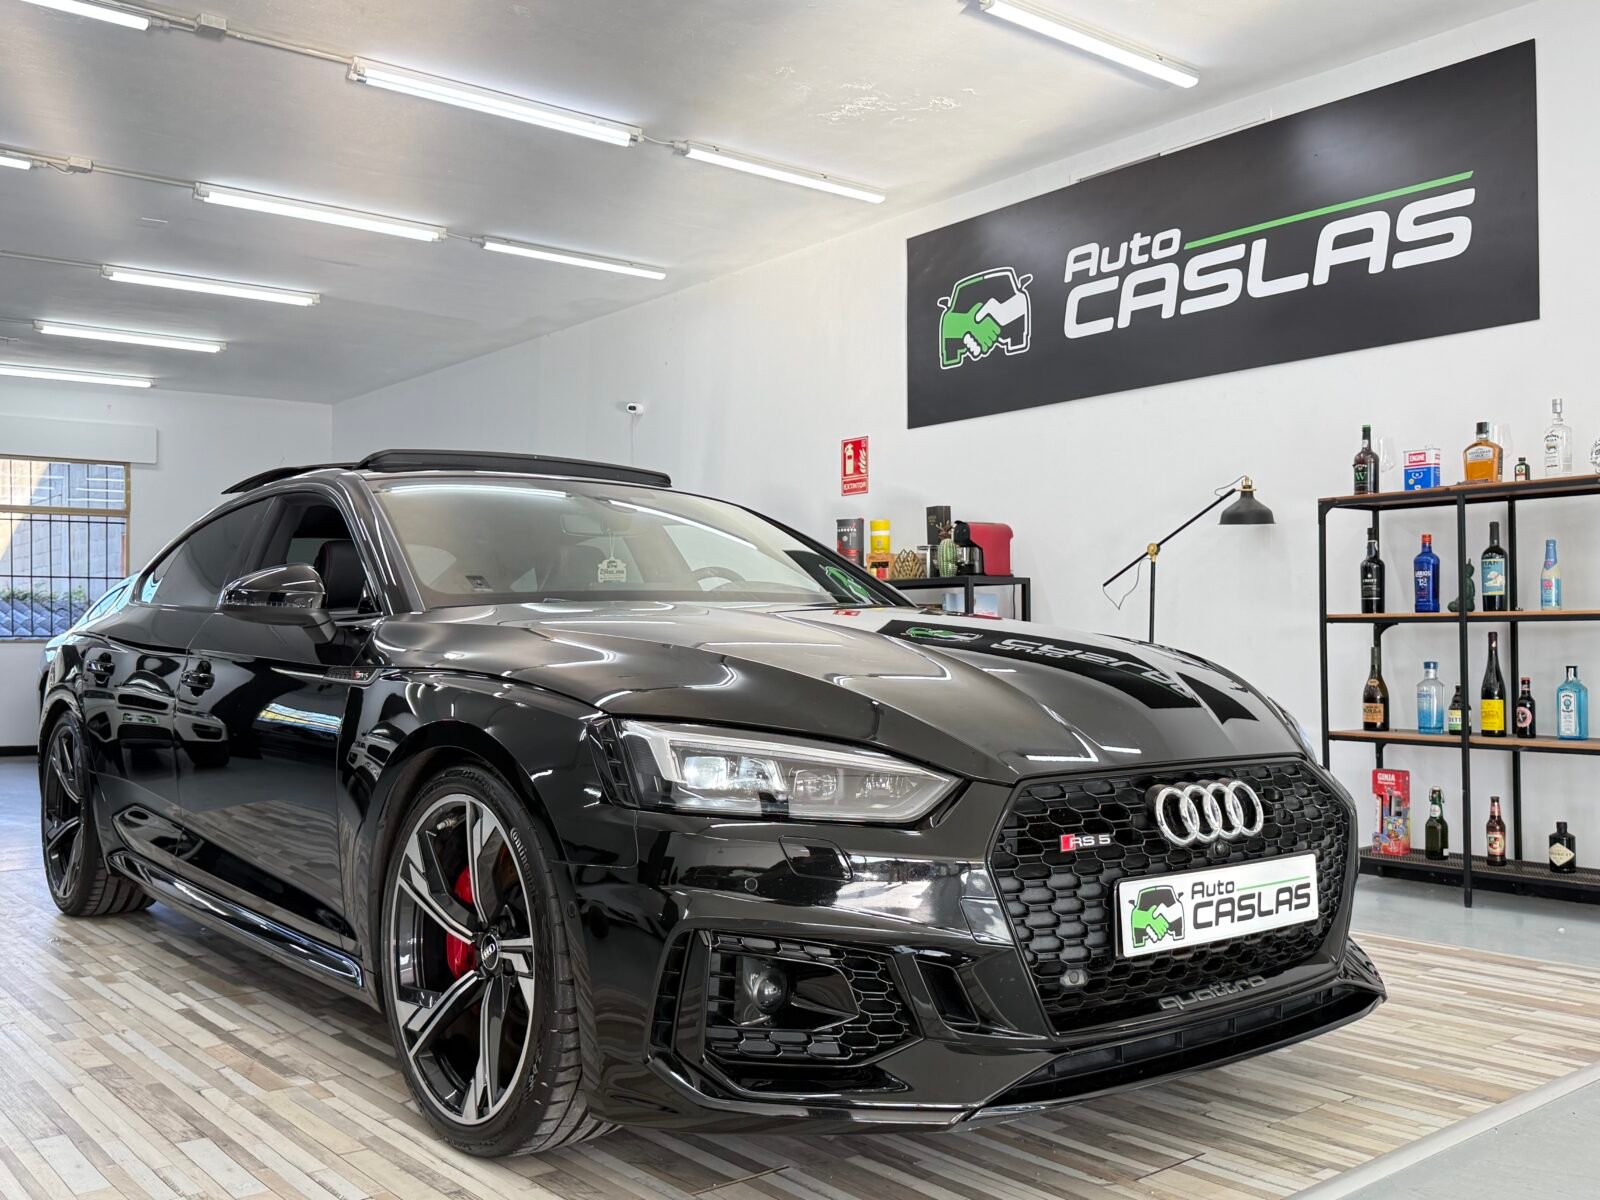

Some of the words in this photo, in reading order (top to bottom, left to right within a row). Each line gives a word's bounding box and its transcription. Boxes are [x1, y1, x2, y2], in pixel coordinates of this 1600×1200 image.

[1063, 188, 1475, 339] CASLAS
[1064, 228, 1181, 283] Auto
[843, 481, 867, 490] EXTINTOR
[1069, 836, 1095, 849] RS
[1098, 834, 1111, 845] 5
[1191, 879, 1235, 899] Auto
[1192, 882, 1311, 930] CASLAS
[1158, 975, 1267, 1010] quattro
